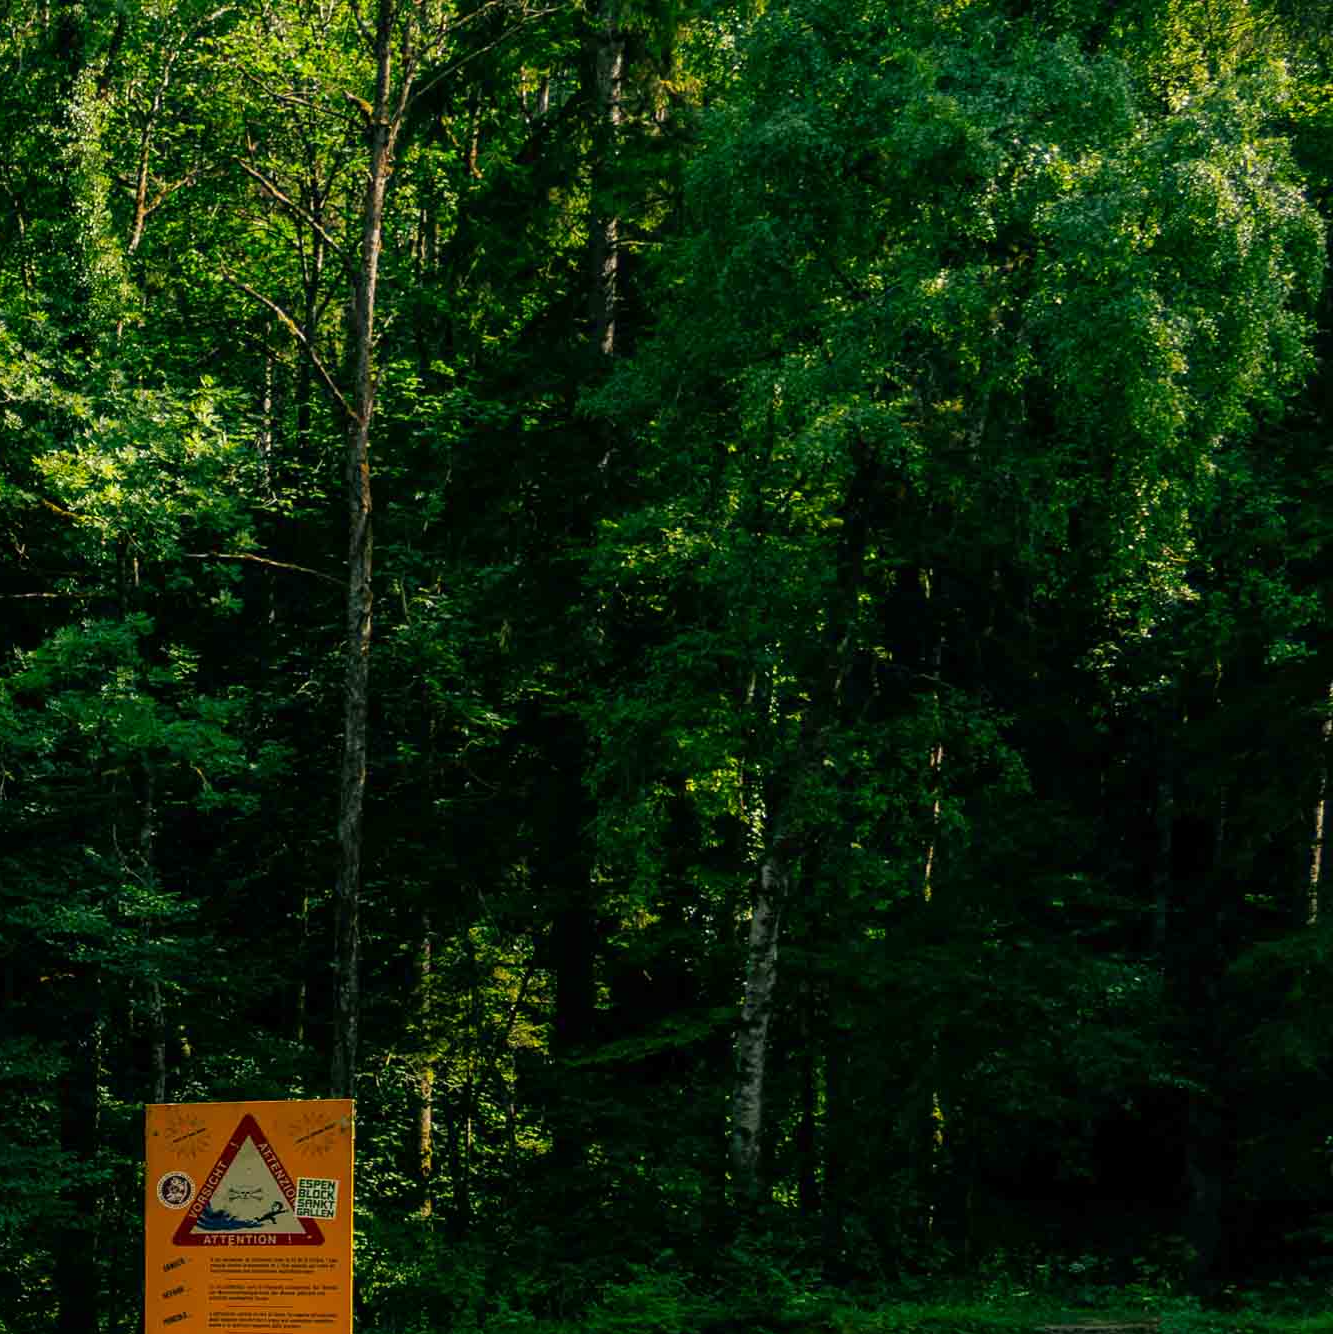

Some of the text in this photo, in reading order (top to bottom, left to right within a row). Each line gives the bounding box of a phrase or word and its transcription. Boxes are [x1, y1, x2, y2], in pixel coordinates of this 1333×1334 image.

[257, 1144, 296, 1203] ATTENZIO
[189, 1161, 227, 1217] VORSICHT
[300, 1179, 335, 1191] ESPEN
[299, 1189, 335, 1200] BLOCK
[298, 1199, 335, 1209] SANKT
[297, 1208, 334, 1217] GALLEN
[204, 1234, 276, 1245] ATTENTION
